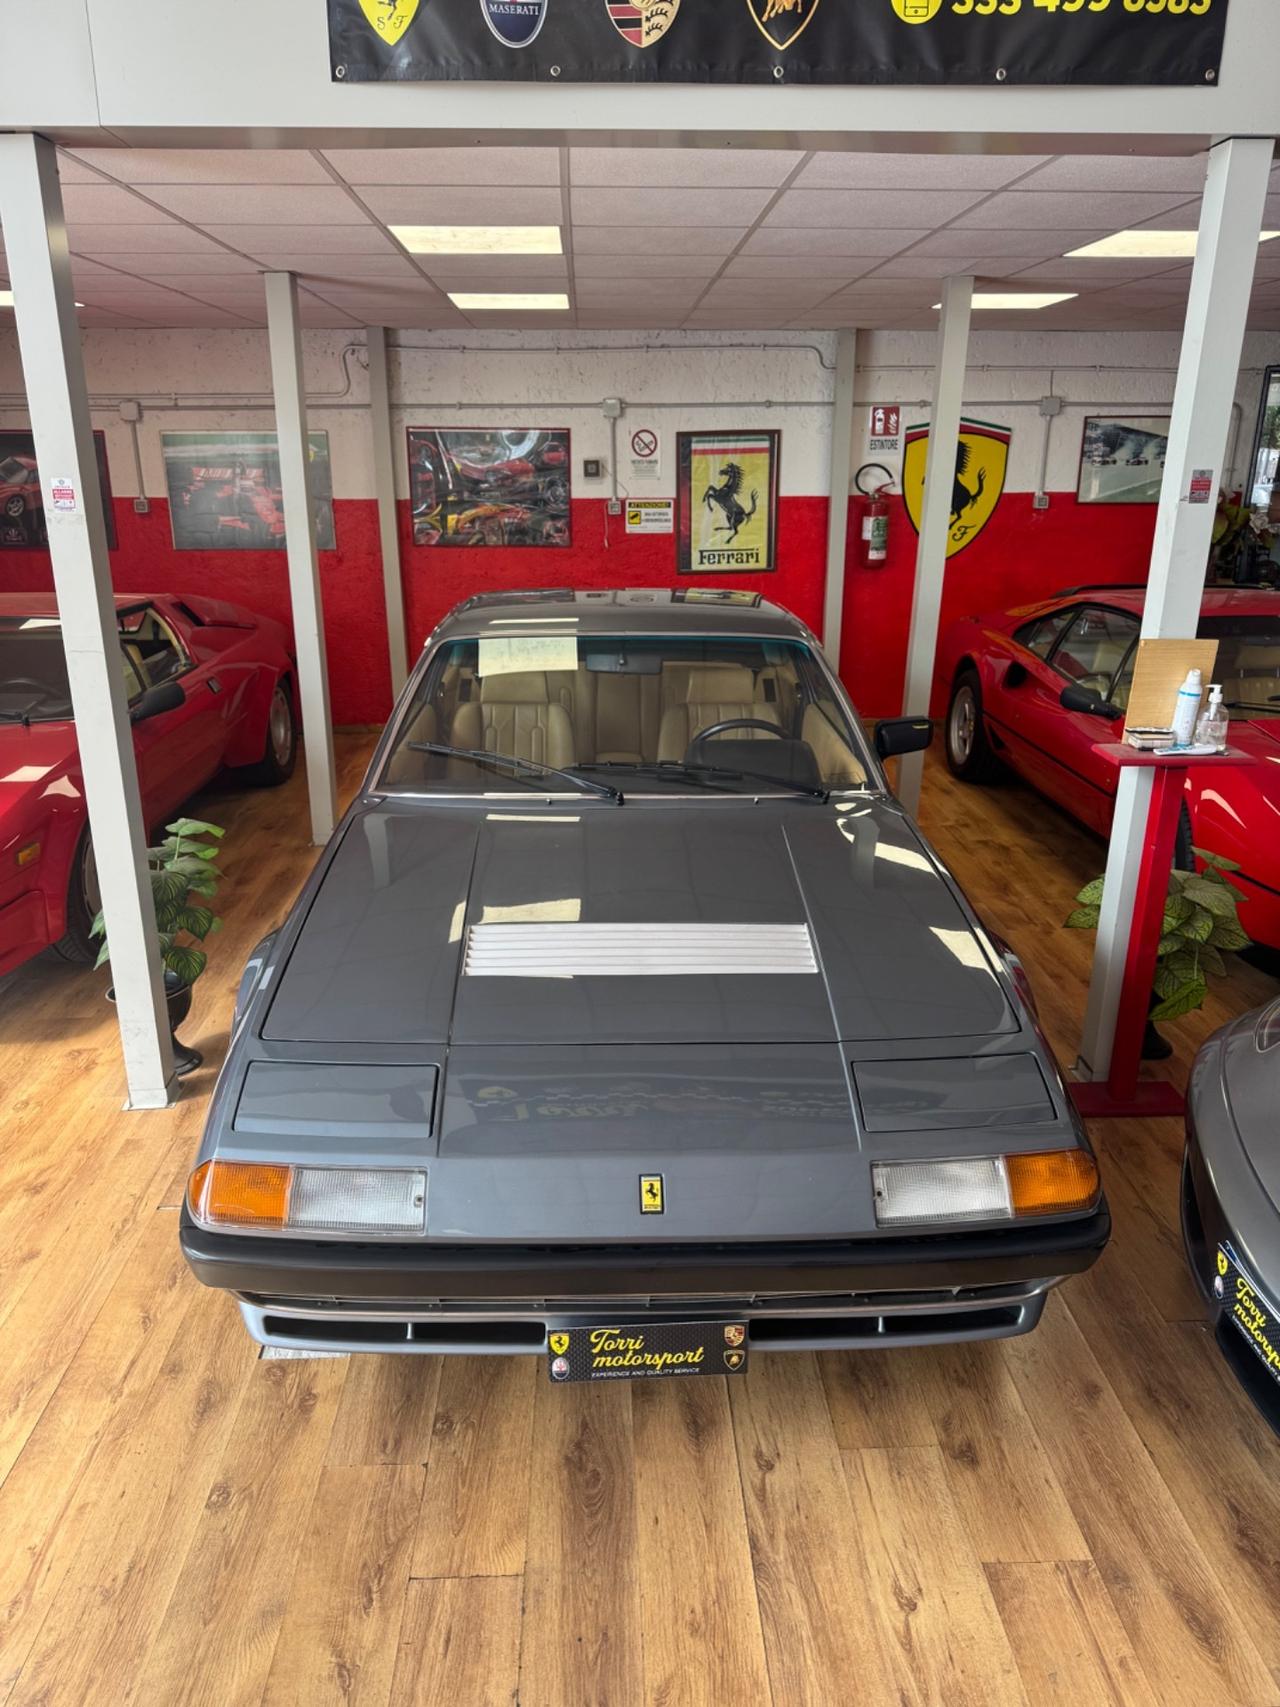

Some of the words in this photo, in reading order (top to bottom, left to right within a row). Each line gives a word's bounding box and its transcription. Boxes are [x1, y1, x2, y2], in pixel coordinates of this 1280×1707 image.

[489, 3, 539, 15] MASERATI
[377, 16, 385, 30] S
[870, 439, 898, 450] ESTINTORE
[698, 548, 760, 565] Ferrari
[1236, 1278, 1266, 1327] Torri
[590, 1329, 644, 1353] Torri
[1234, 1303, 1280, 1370] motorsp
[592, 1347, 705, 1370] motorsport
